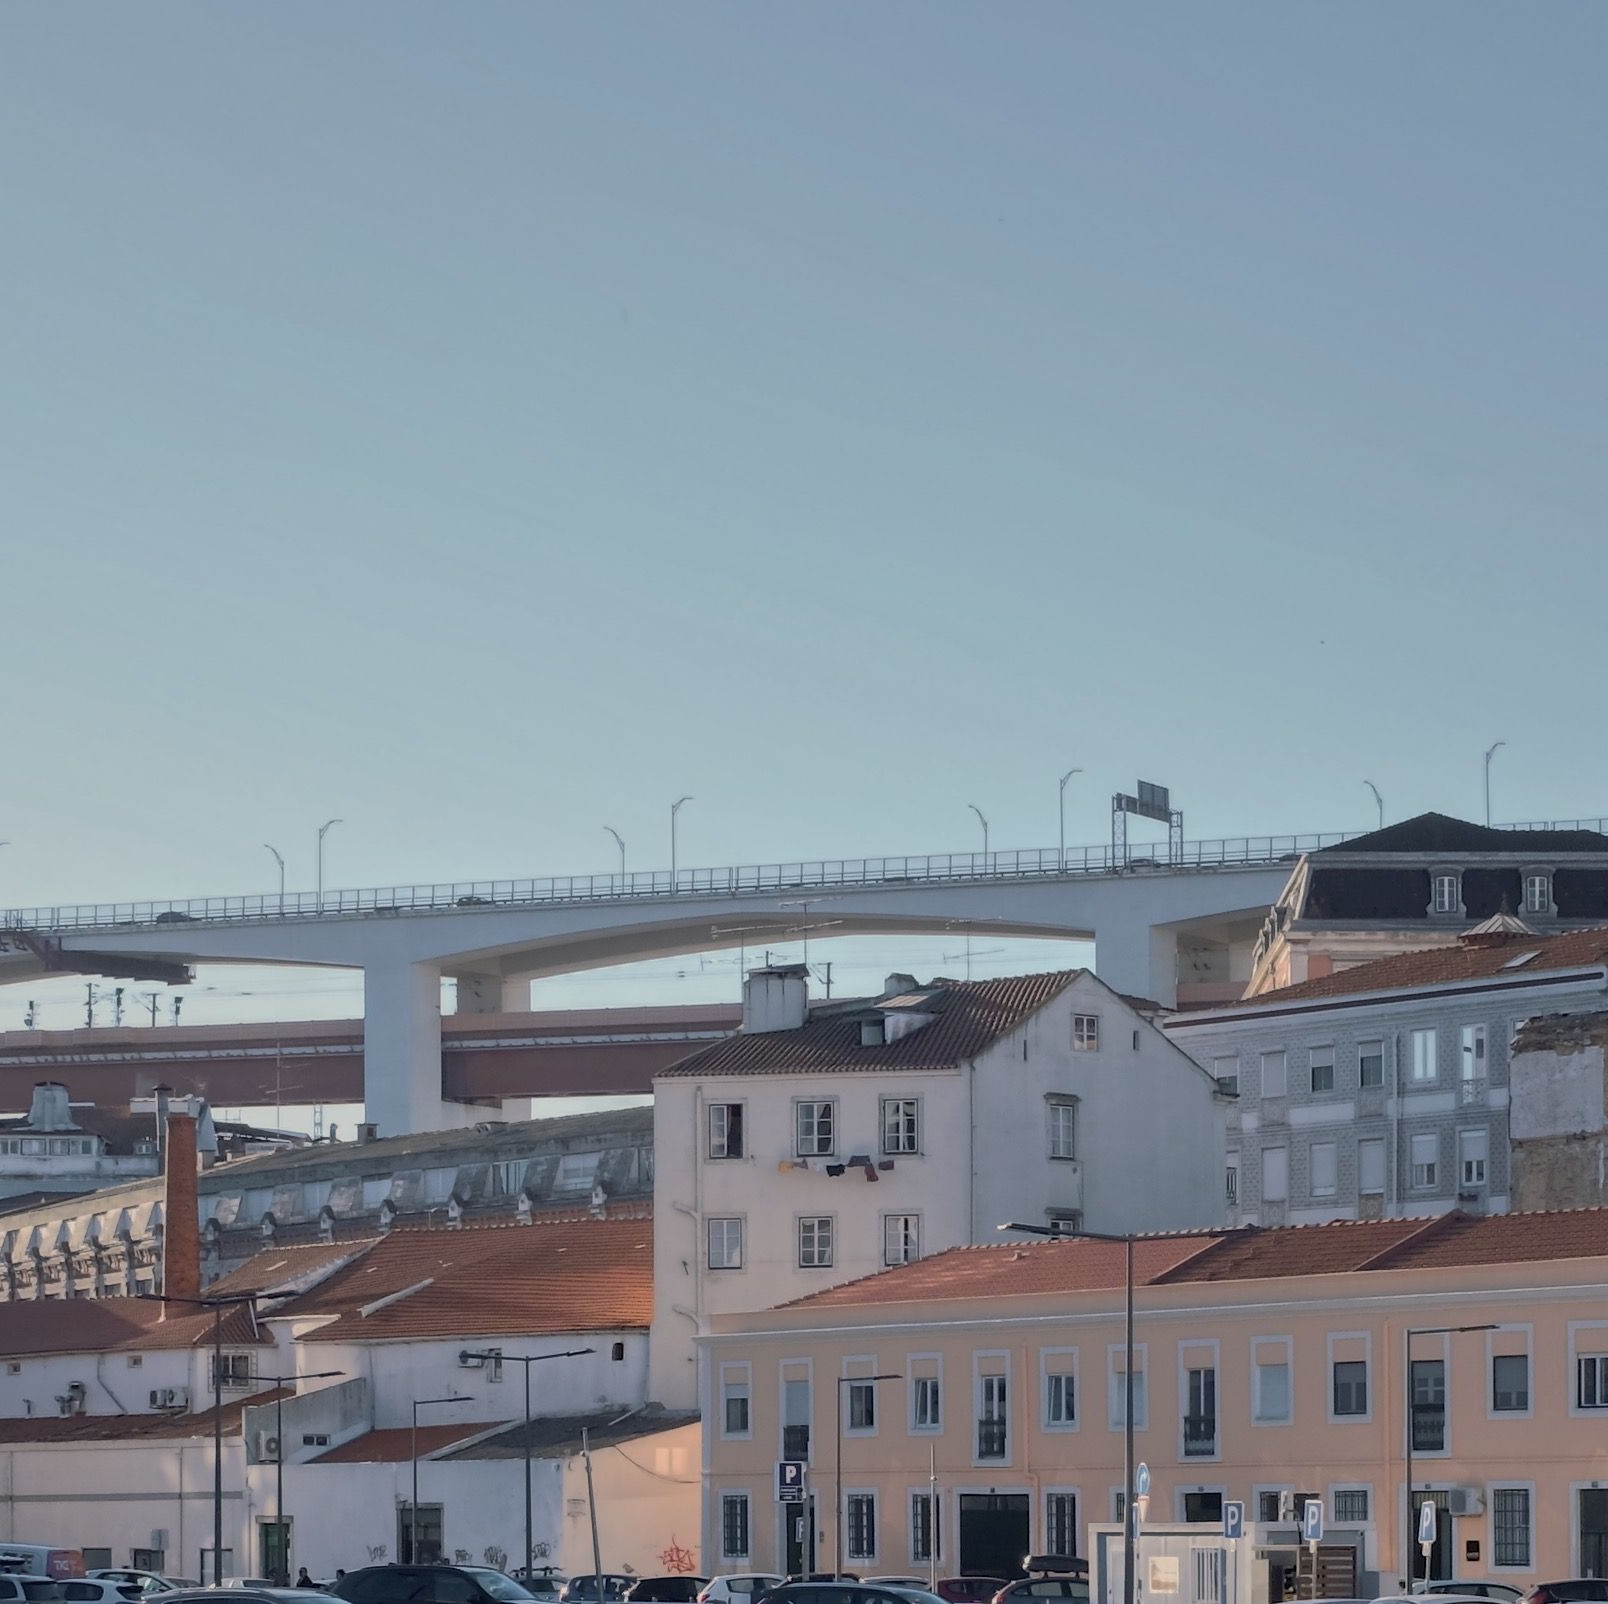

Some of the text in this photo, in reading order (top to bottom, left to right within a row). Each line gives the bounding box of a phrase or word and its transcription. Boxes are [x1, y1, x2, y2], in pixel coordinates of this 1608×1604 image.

[785, 1465, 797, 1484] P
[1227, 1505, 1239, 1536] P
[1308, 1505, 1318, 1536] P
[1422, 1507, 1431, 1538] P
